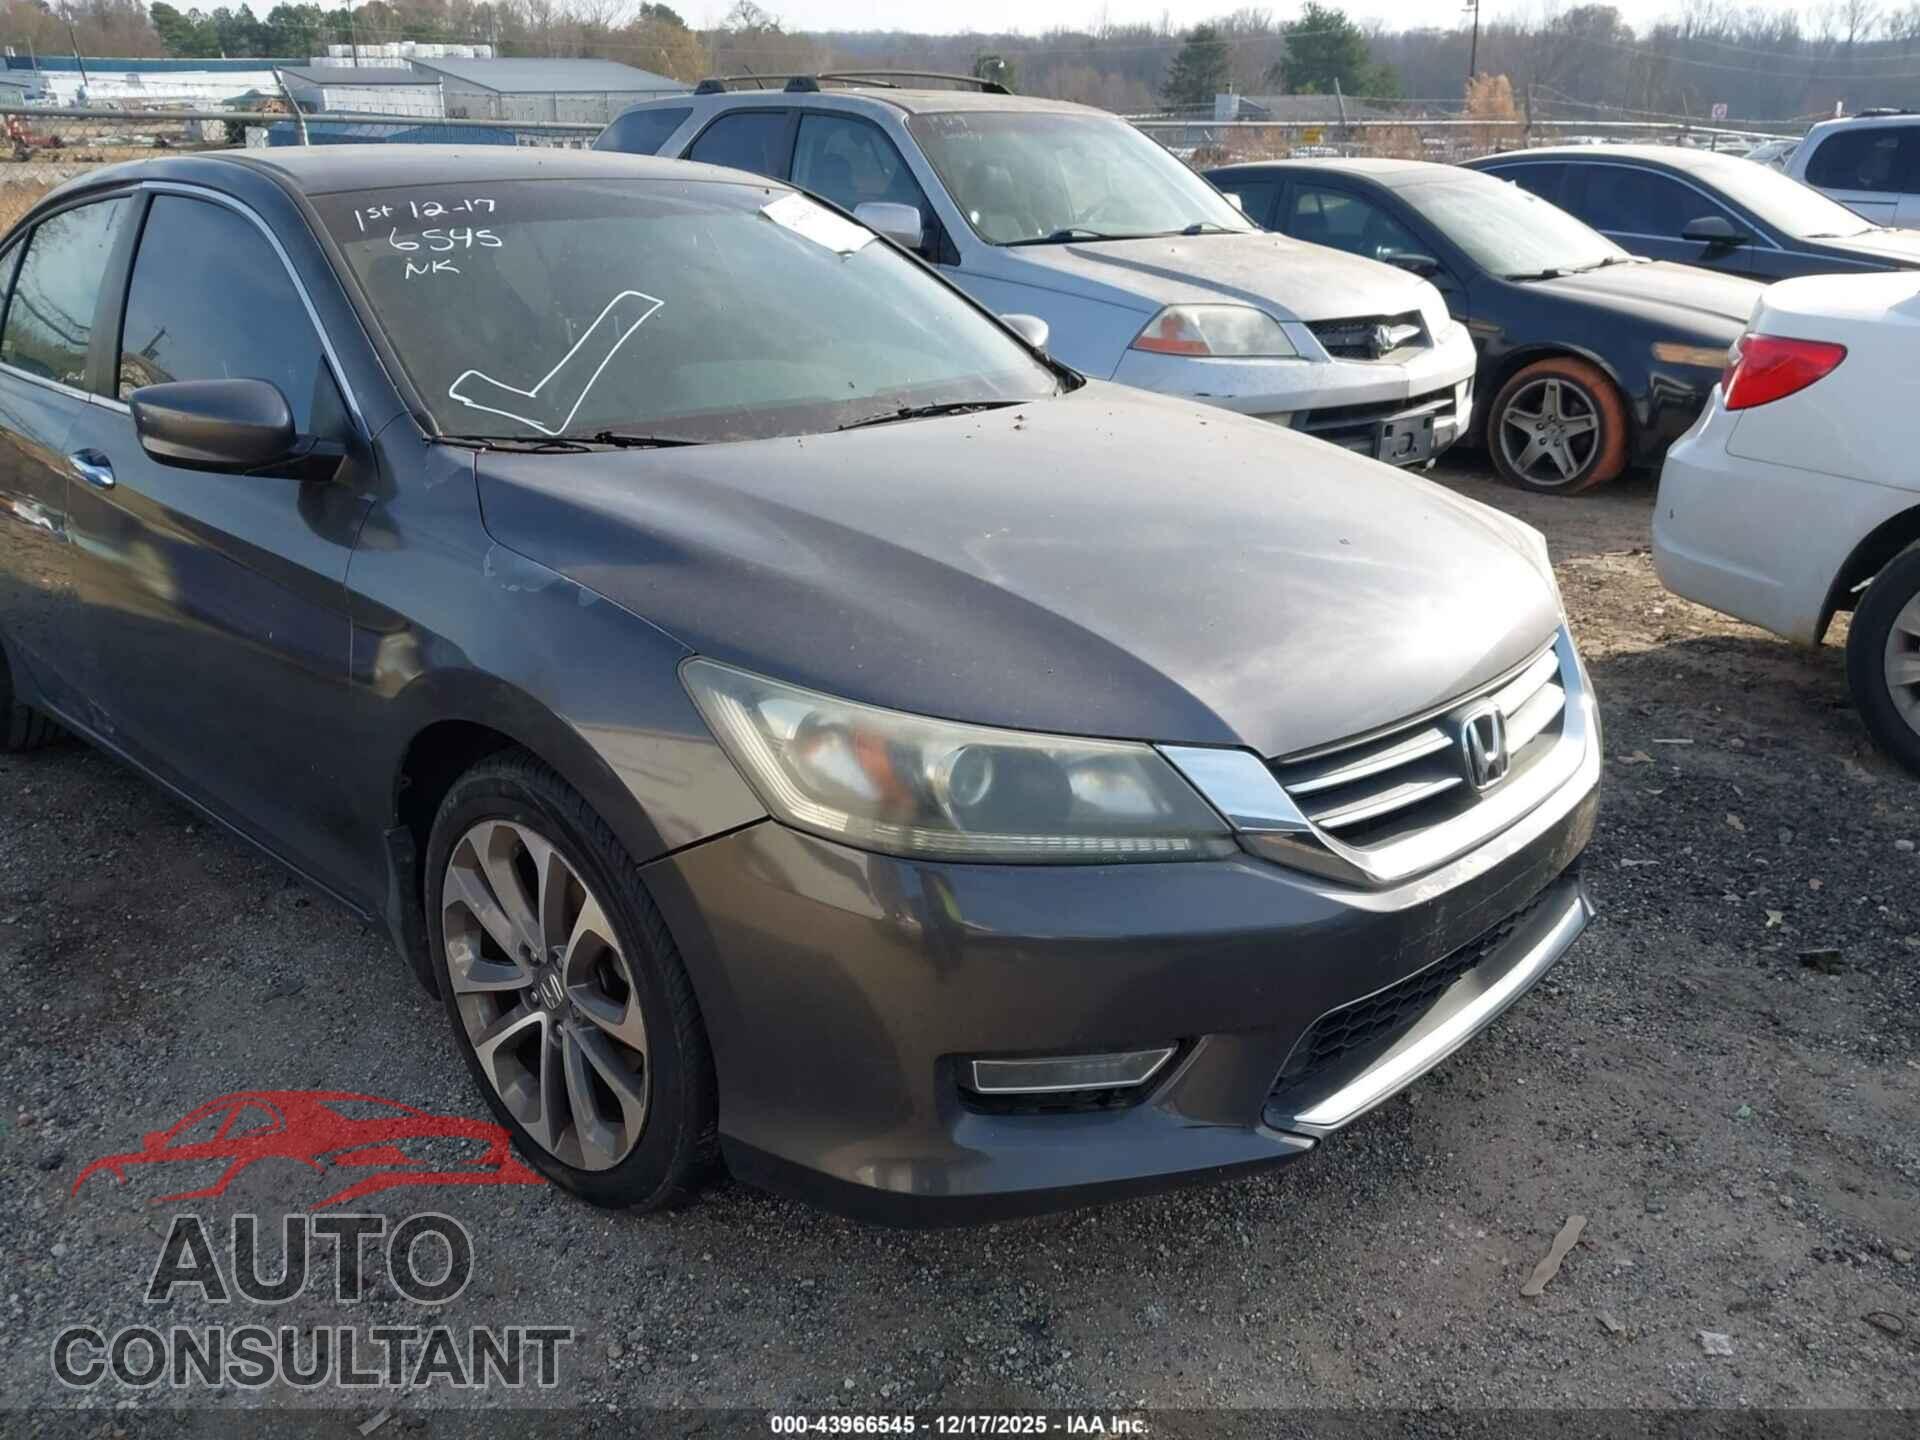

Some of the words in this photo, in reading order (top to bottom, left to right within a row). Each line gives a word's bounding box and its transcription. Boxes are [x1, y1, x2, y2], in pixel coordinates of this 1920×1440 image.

[354, 204, 393, 232] 1st
[408, 198, 496, 219] 12-17
[388, 226, 503, 251] 6545
